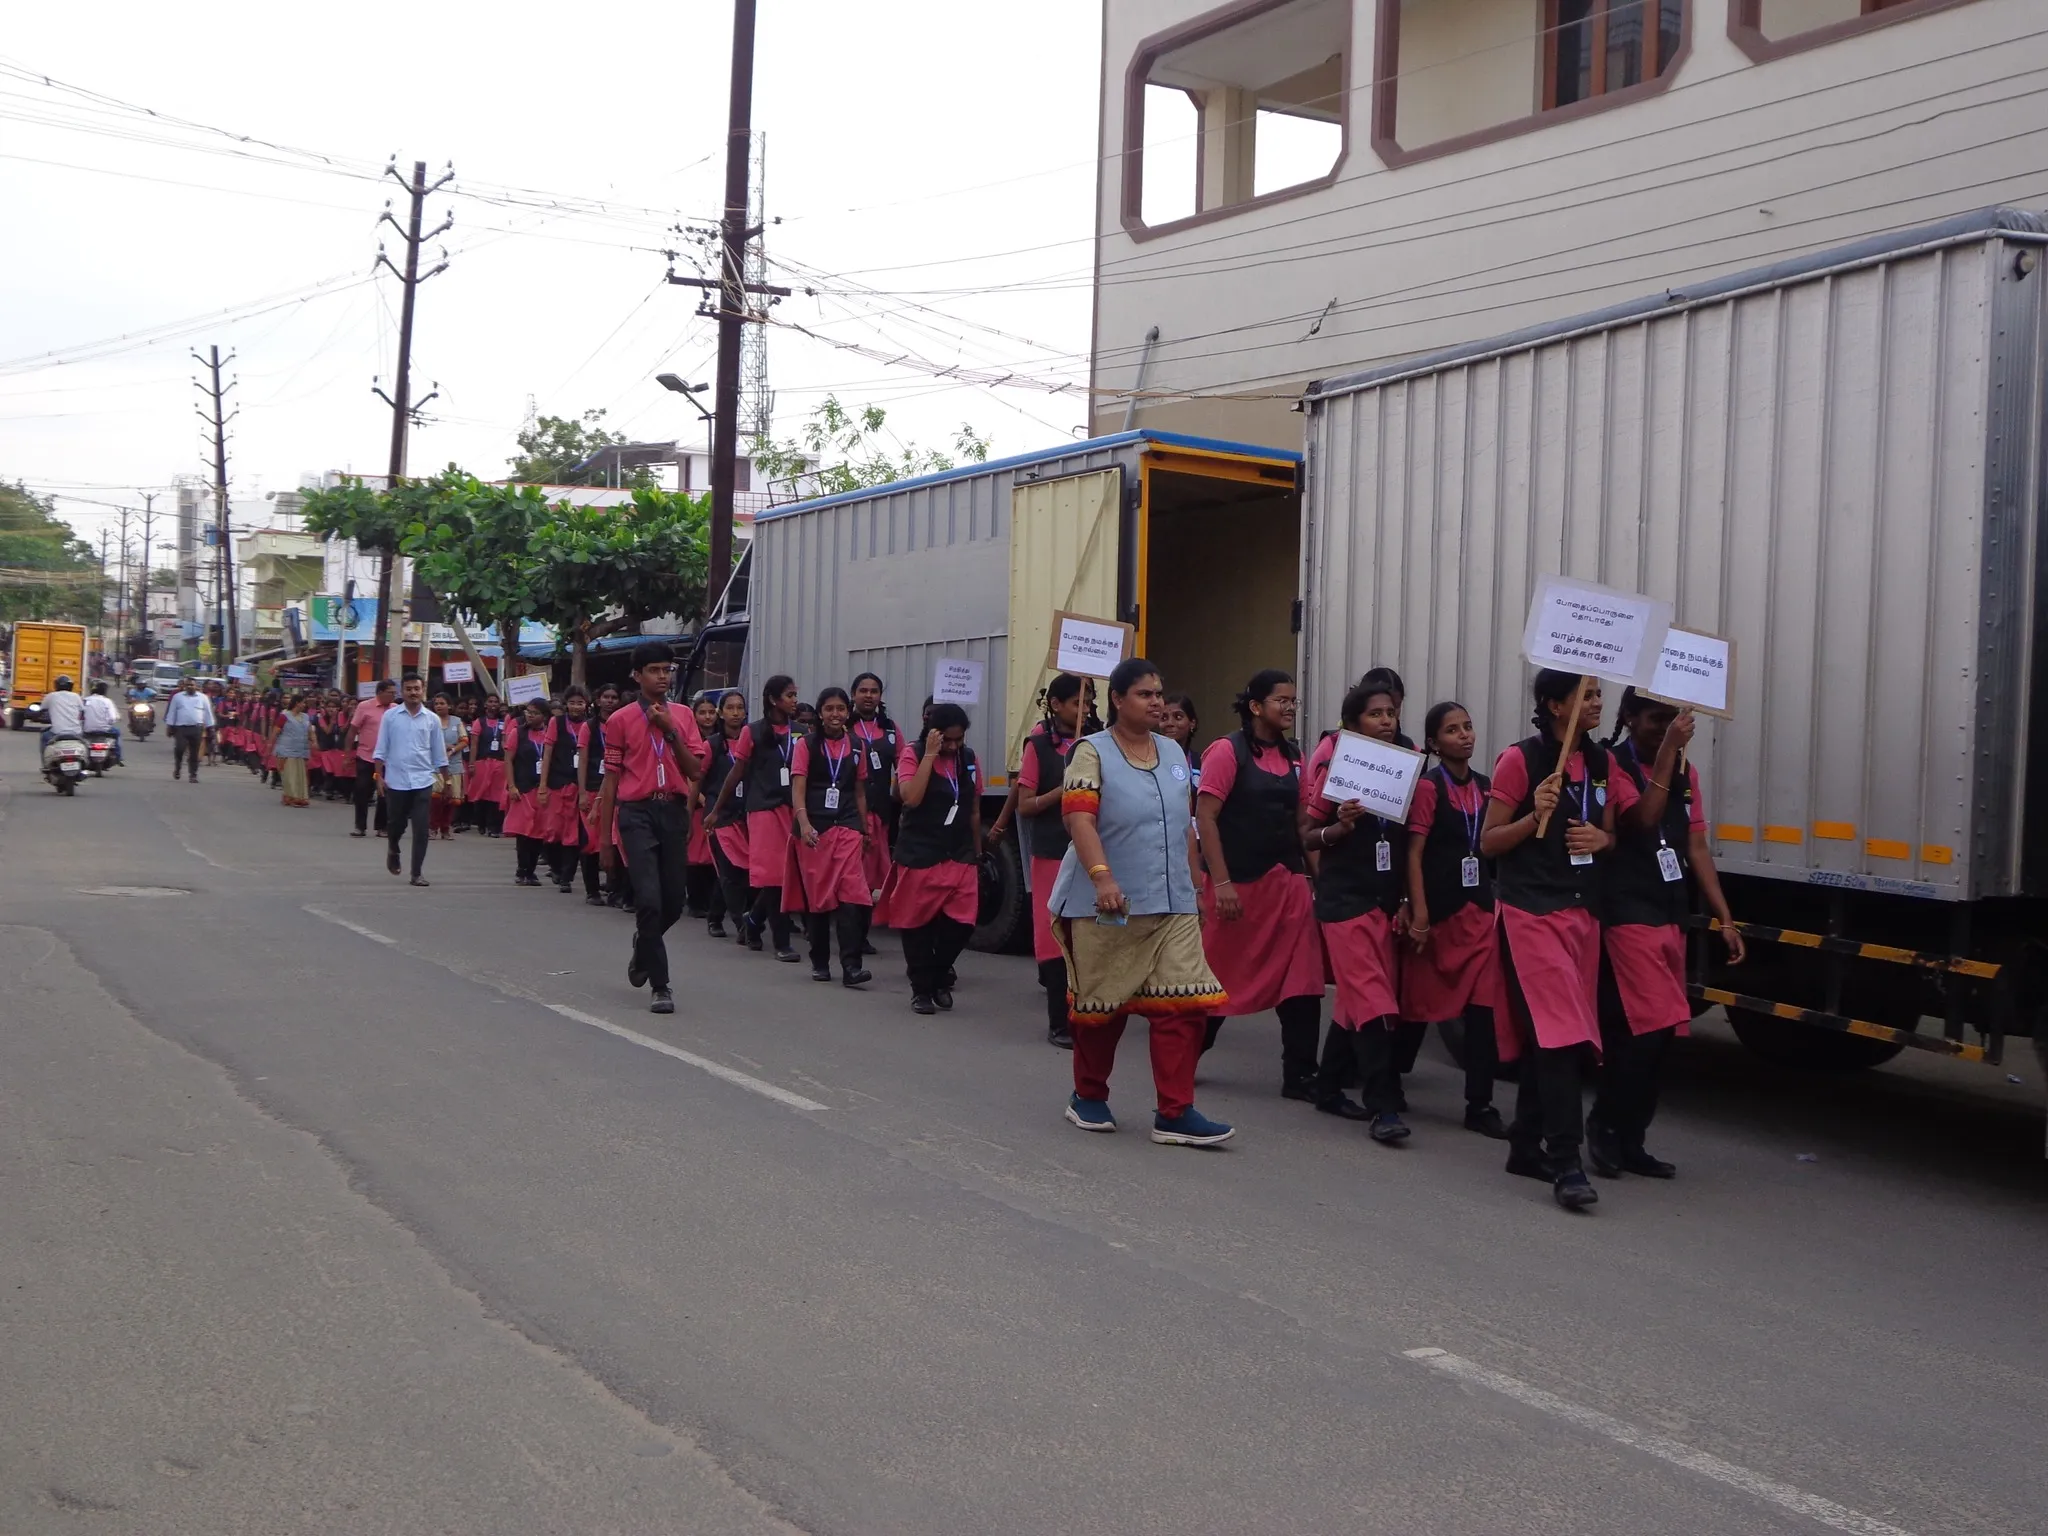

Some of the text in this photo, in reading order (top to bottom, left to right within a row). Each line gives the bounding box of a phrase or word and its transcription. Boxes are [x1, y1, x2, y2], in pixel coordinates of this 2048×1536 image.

[1556, 598, 1634, 621] போதைப்பொருளை
[1571, 611, 1614, 627] தொடாதே!
[1550, 630, 1623, 653] வாழ்க்கையை
[1552, 644, 1615, 664] இழக்காதே!!
[1687, 653, 1724, 669] நமக்குத்
[1664, 660, 1710, 677] தொல்லை
[1343, 754, 1403, 780] போதையில் நீ
[1361, 786, 1403, 806] குடும்பம்
